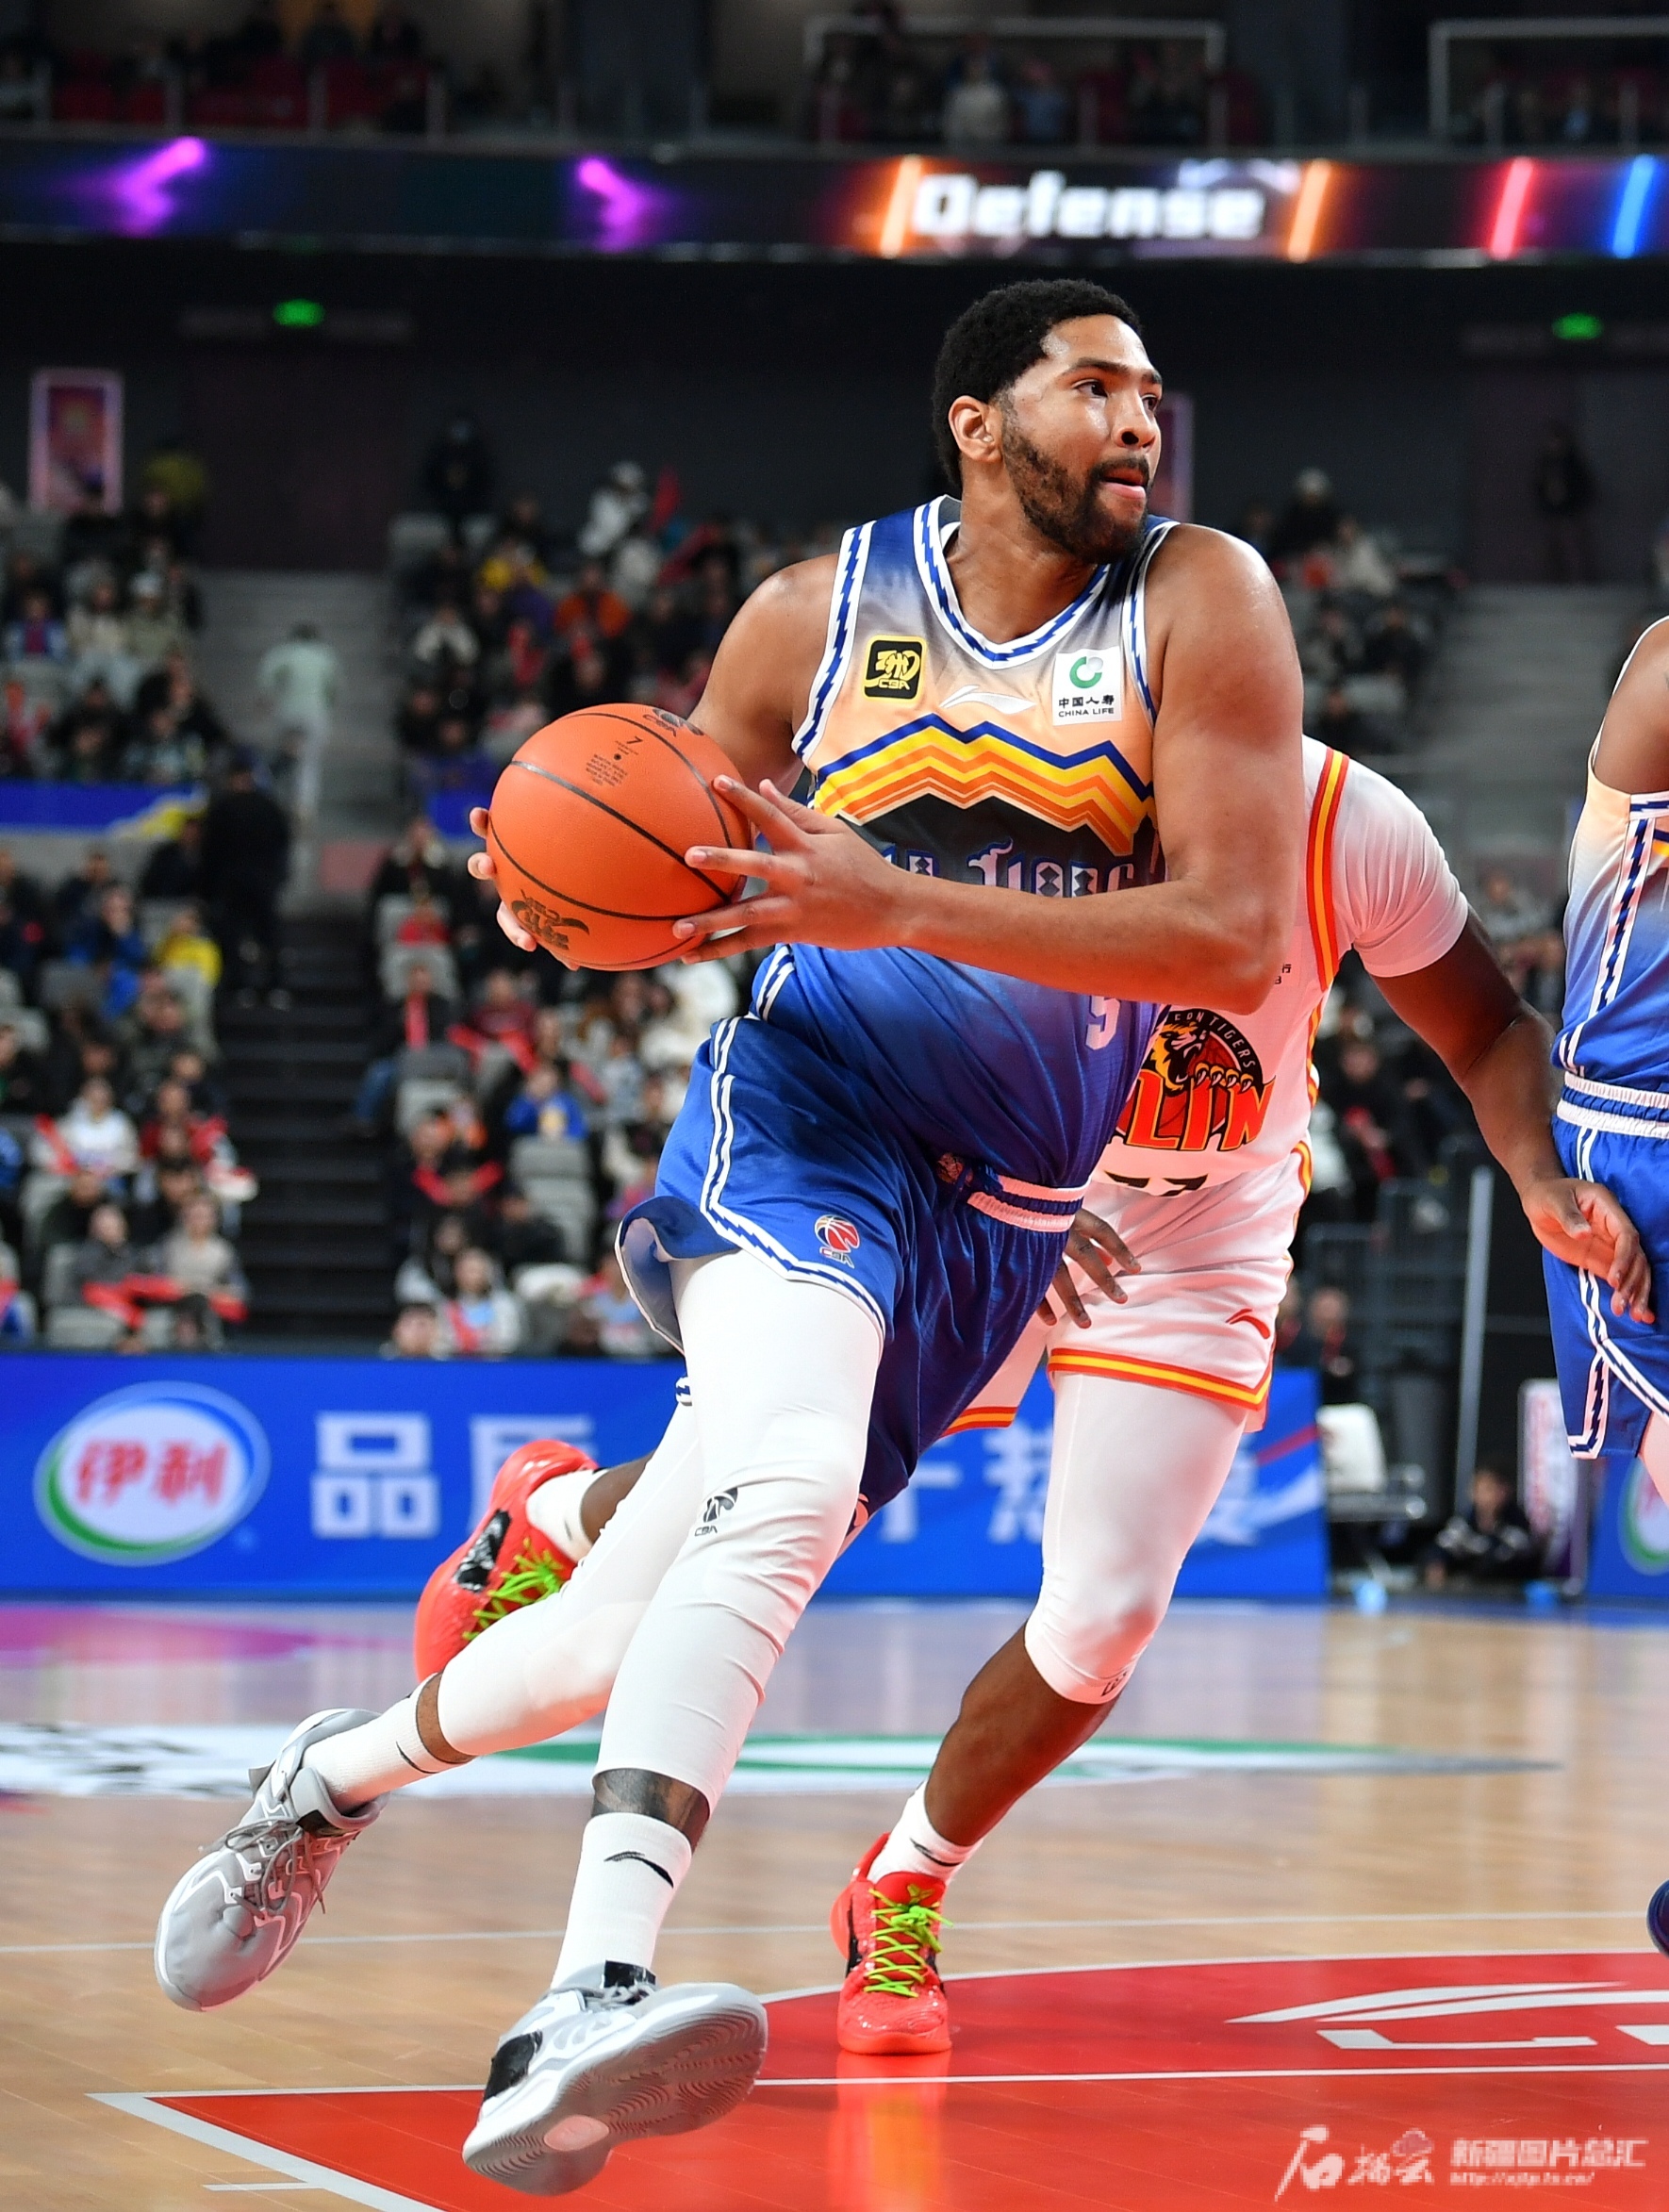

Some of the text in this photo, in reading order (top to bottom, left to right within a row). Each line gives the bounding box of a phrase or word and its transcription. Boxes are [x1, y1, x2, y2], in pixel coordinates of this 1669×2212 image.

[911, 170, 1265, 239] Defense
[878, 679, 911, 690] CBA
[1058, 694, 1115, 709] 中国人寿
[1058, 709, 1089, 718] CHINA
[1208, 1015, 1256, 1068] TIGERS
[1108, 1067, 1276, 1152] LIN
[75, 1437, 230, 1507] 伊利
